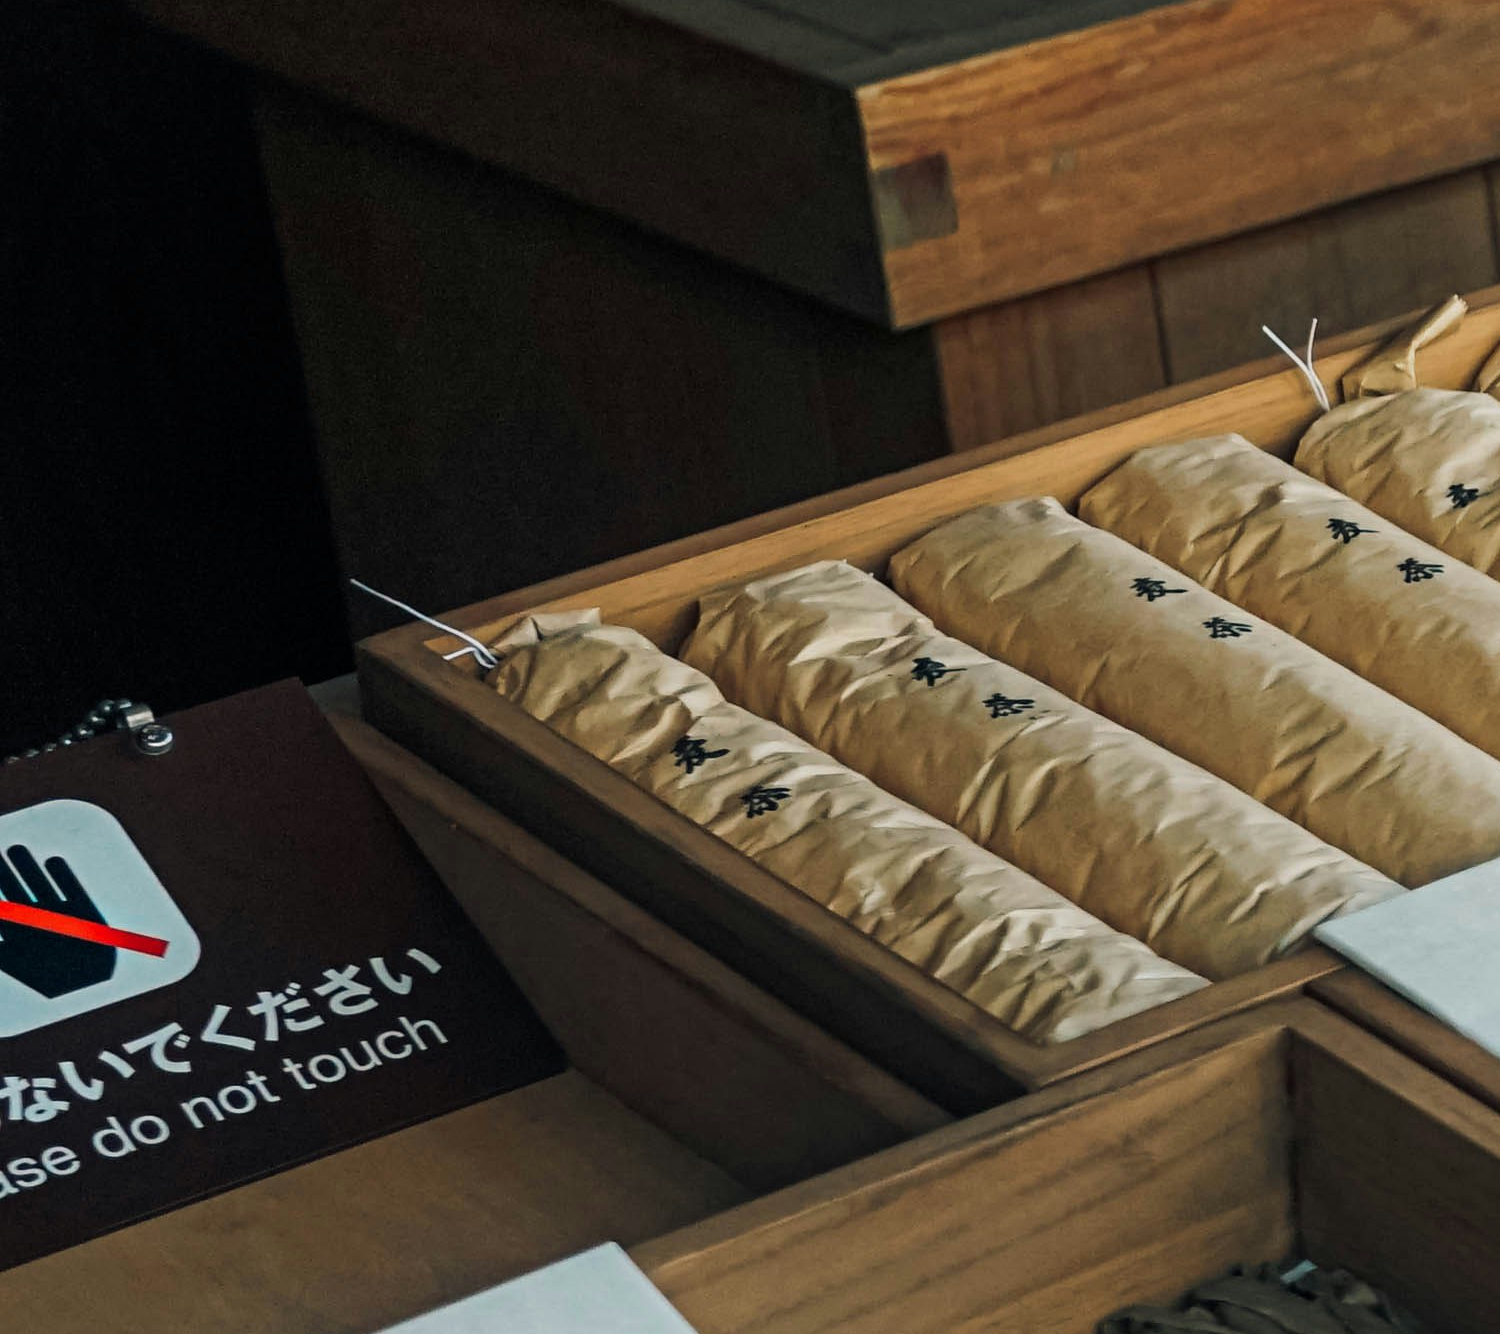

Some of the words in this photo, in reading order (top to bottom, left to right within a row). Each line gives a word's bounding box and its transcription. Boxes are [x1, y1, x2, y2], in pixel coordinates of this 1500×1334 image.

[0, 948, 442, 1123] ないでください
[93, 1116, 170, 1158] do
[182, 1071, 281, 1129] not
[282, 1015, 448, 1091] touch
